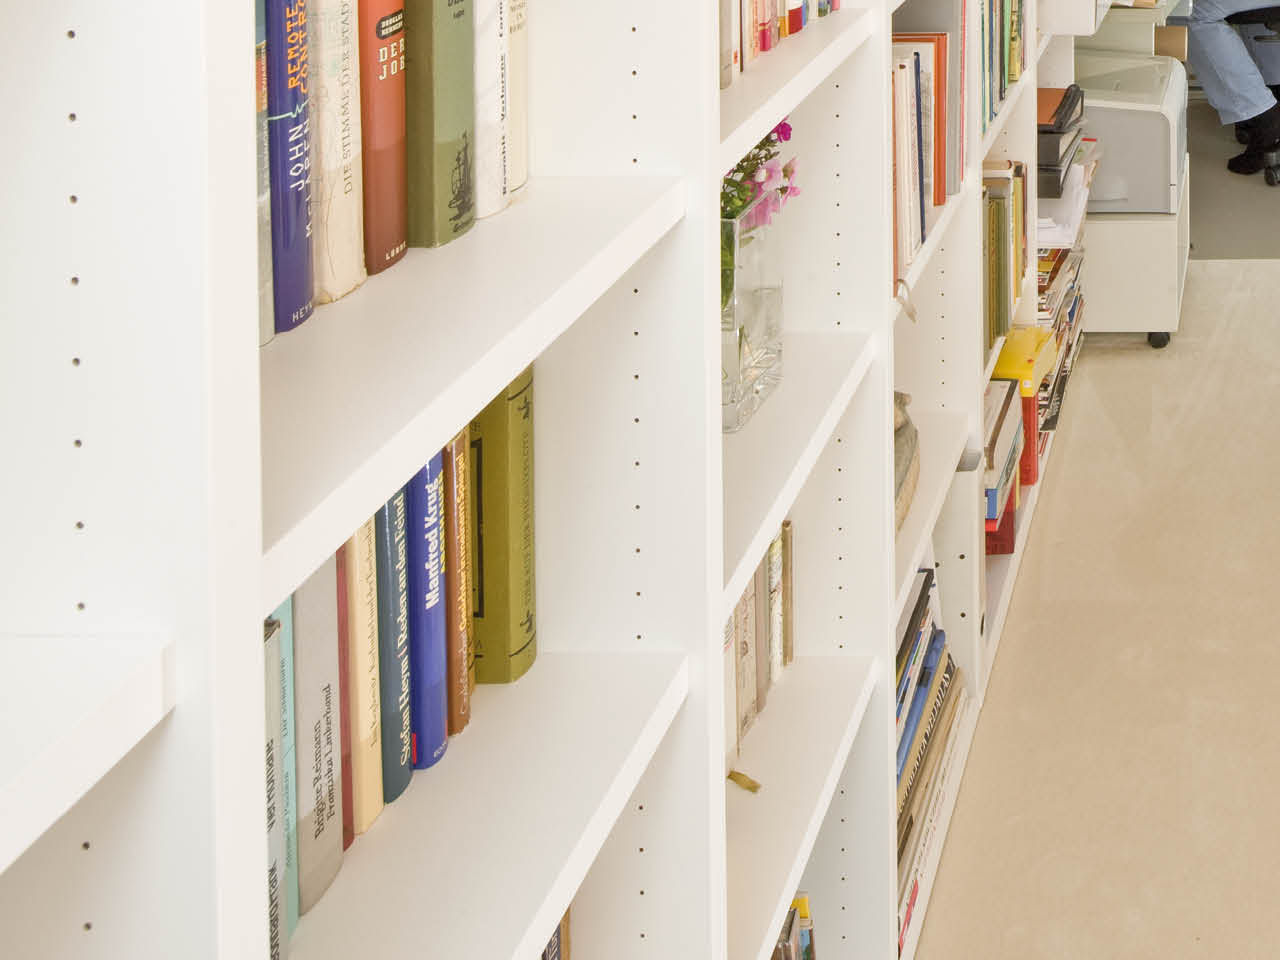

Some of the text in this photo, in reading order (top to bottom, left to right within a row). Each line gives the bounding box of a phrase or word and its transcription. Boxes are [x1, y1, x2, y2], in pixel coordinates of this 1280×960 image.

[286, 3, 300, 88] REMOTE
[341, 50, 352, 88] DER
[379, 38, 405, 63] DER
[379, 55, 405, 80] JOB
[289, 123, 305, 191] JOHN
[343, 162, 353, 194] DIE
[393, 493, 406, 544] Feind
[424, 477, 440, 610] Manfred Krug
[395, 543, 406, 575] den
[398, 574, 407, 593] an
[396, 593, 408, 648] Reden
[399, 657, 411, 707] Heym
[400, 707, 411, 765] Stefan
[312, 721, 326, 839] Brigitte Reimann
[323, 757, 335, 820] Franziska
